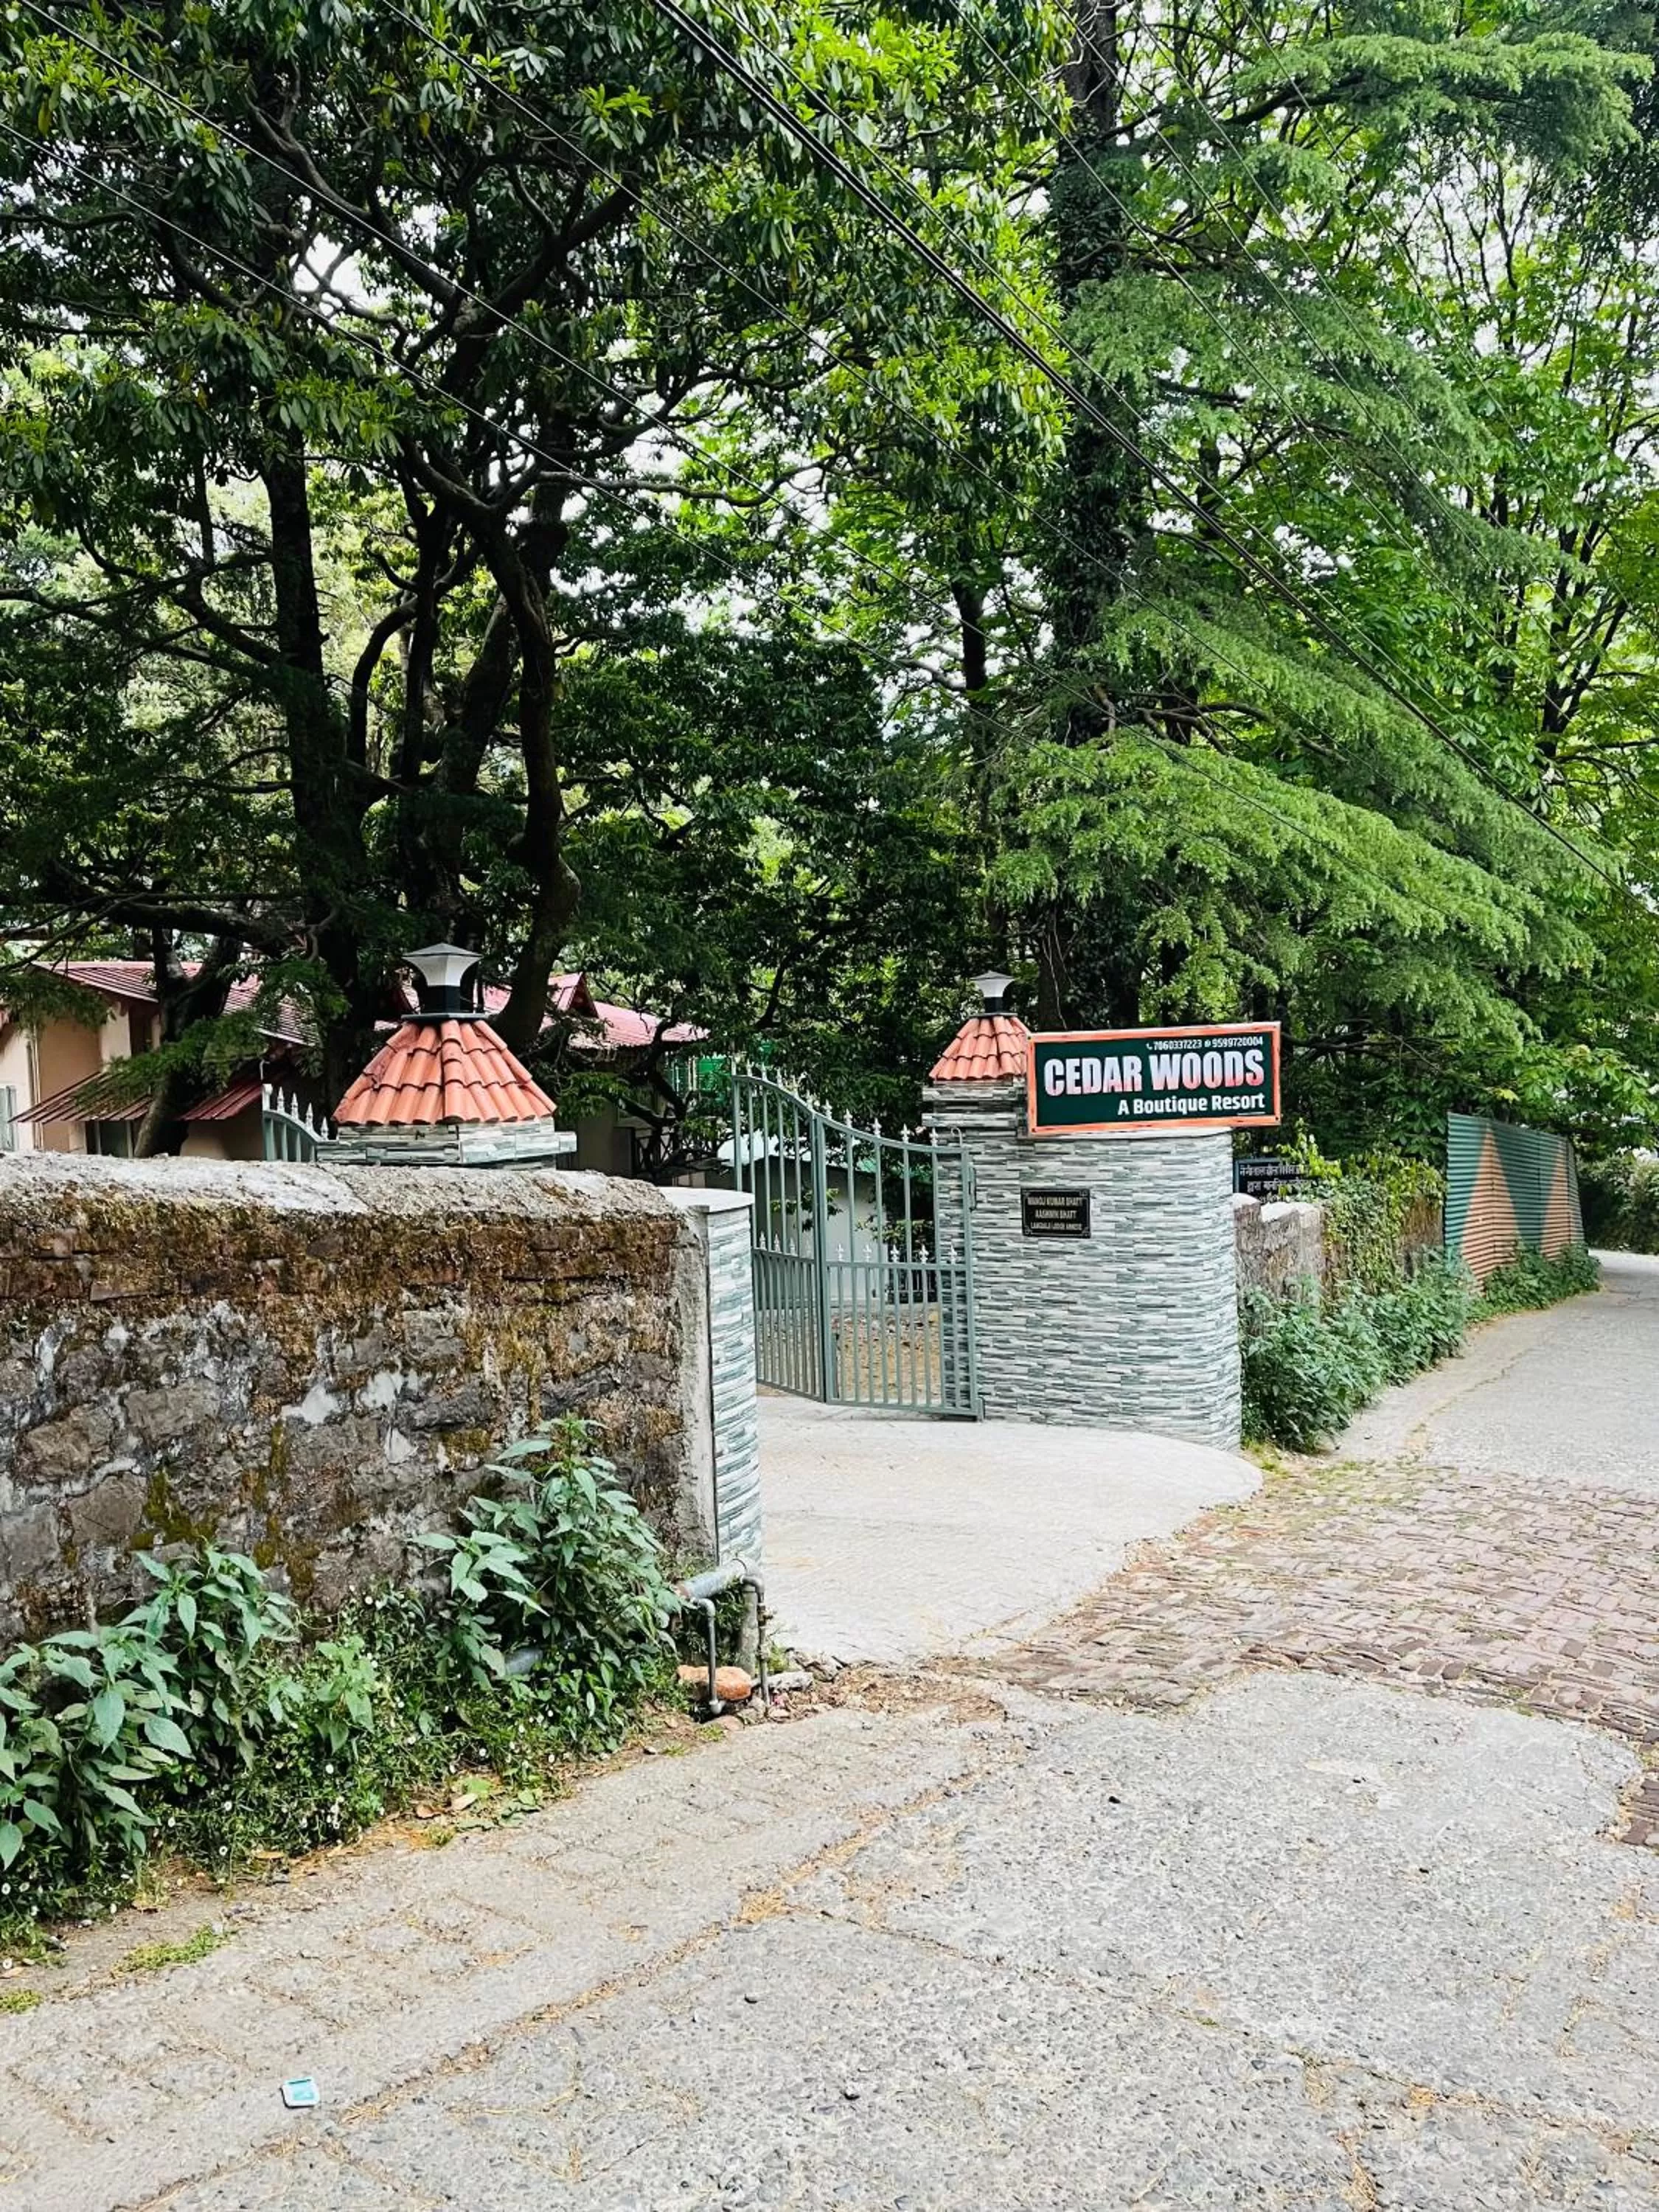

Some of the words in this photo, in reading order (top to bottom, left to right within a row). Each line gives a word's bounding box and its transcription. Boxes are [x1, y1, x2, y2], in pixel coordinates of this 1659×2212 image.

[1043, 1056, 1143, 1096] CEDAR
[1149, 1049, 1265, 1091] WOODS
[1117, 1099, 1130, 1116] A
[1133, 1096, 1208, 1116] Boutique
[1211, 1093, 1266, 1110] Resort
